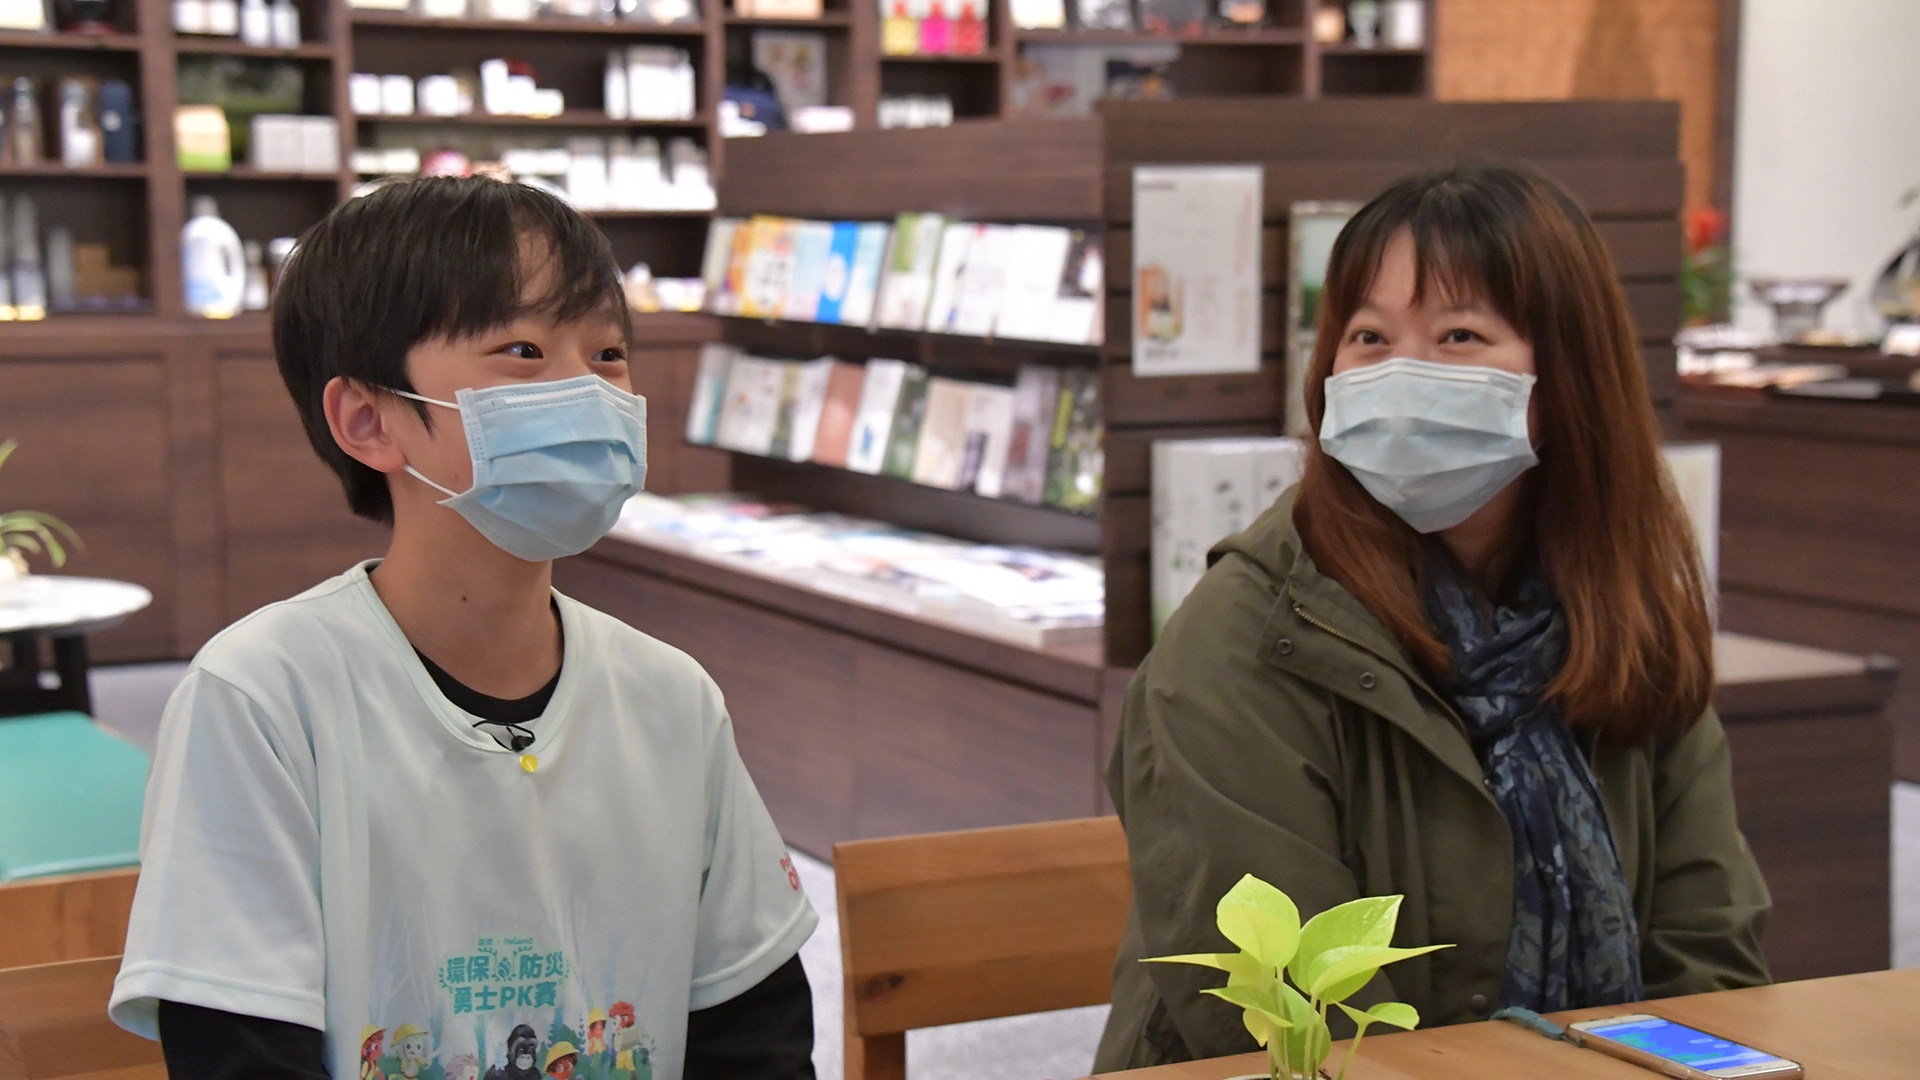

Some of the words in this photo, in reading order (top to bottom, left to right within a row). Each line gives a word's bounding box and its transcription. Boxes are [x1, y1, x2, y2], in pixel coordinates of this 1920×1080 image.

[447, 955, 490, 984] 環保
[519, 951, 564, 980] 防災
[453, 981, 558, 1014] 勇士PK賽
